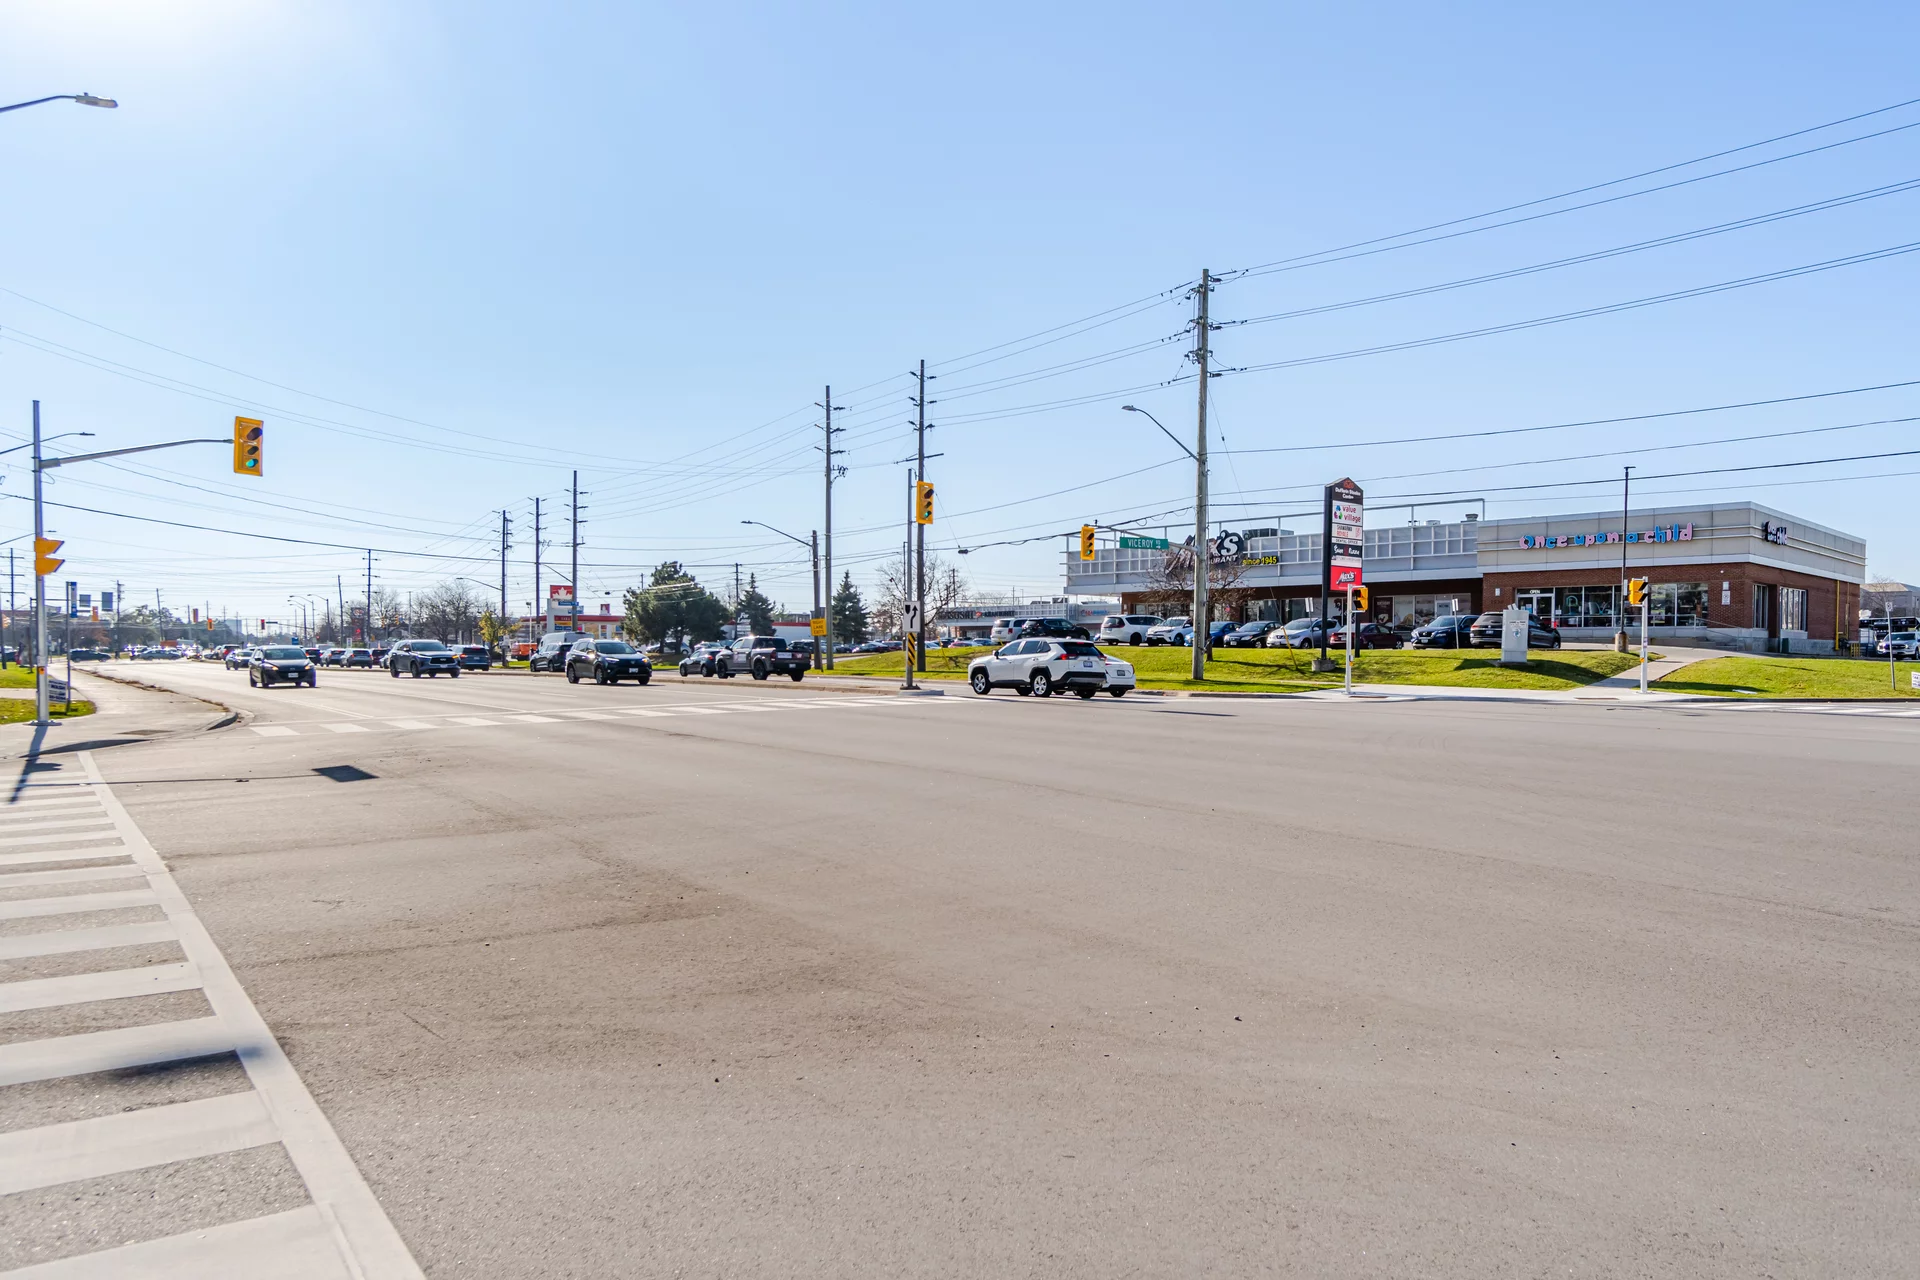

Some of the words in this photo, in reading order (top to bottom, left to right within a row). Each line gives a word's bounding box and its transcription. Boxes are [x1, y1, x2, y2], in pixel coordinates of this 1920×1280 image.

[1342, 505, 1356, 513] value
[1344, 514, 1361, 523] village
[1520, 535, 1568, 550] Once
[1574, 532, 1619, 548] upon
[1626, 532, 1638, 544] a
[1644, 522, 1693, 544] child
[1128, 539, 1153, 548] VICEROY
[1261, 556, 1277, 565] 1945
